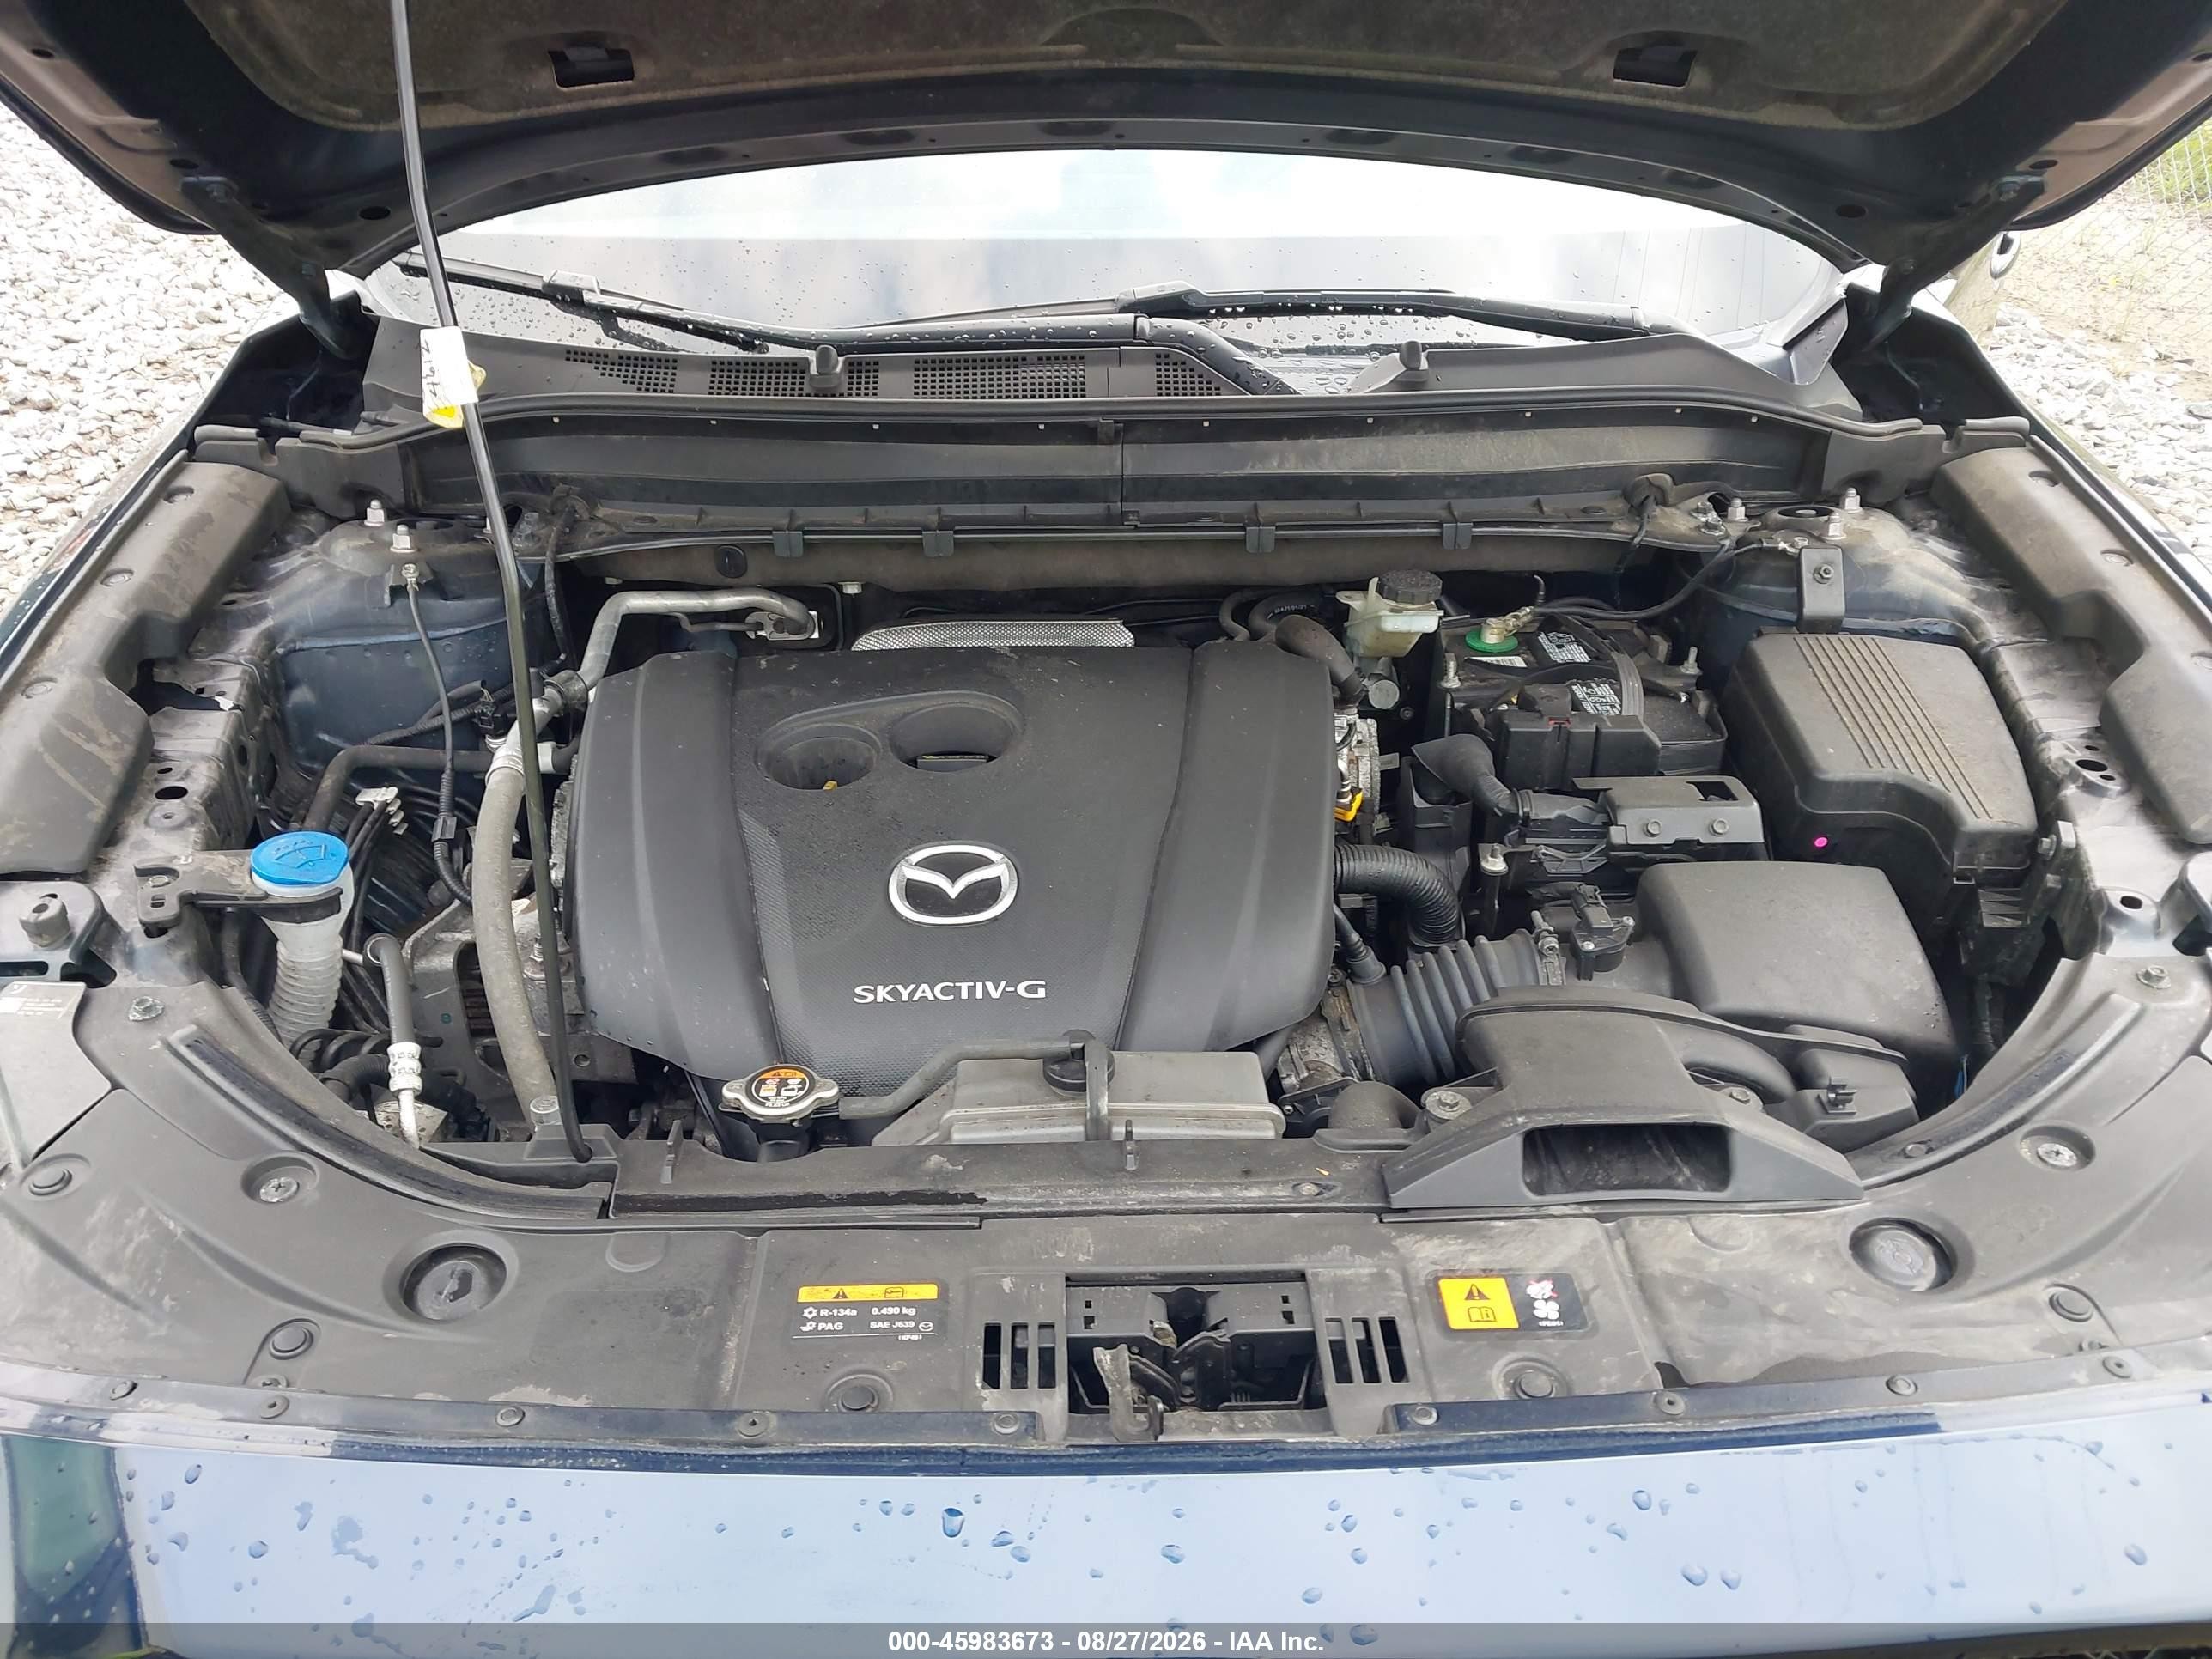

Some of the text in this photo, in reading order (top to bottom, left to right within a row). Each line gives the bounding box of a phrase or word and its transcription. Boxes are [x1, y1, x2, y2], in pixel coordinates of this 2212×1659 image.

[854, 980, 1047, 1004] SKYACTIV-G
[819, 1306, 917, 1317] R-134a 0.490 kg
[817, 1322, 844, 1331] PAG
[869, 1321, 891, 1329] SAE
